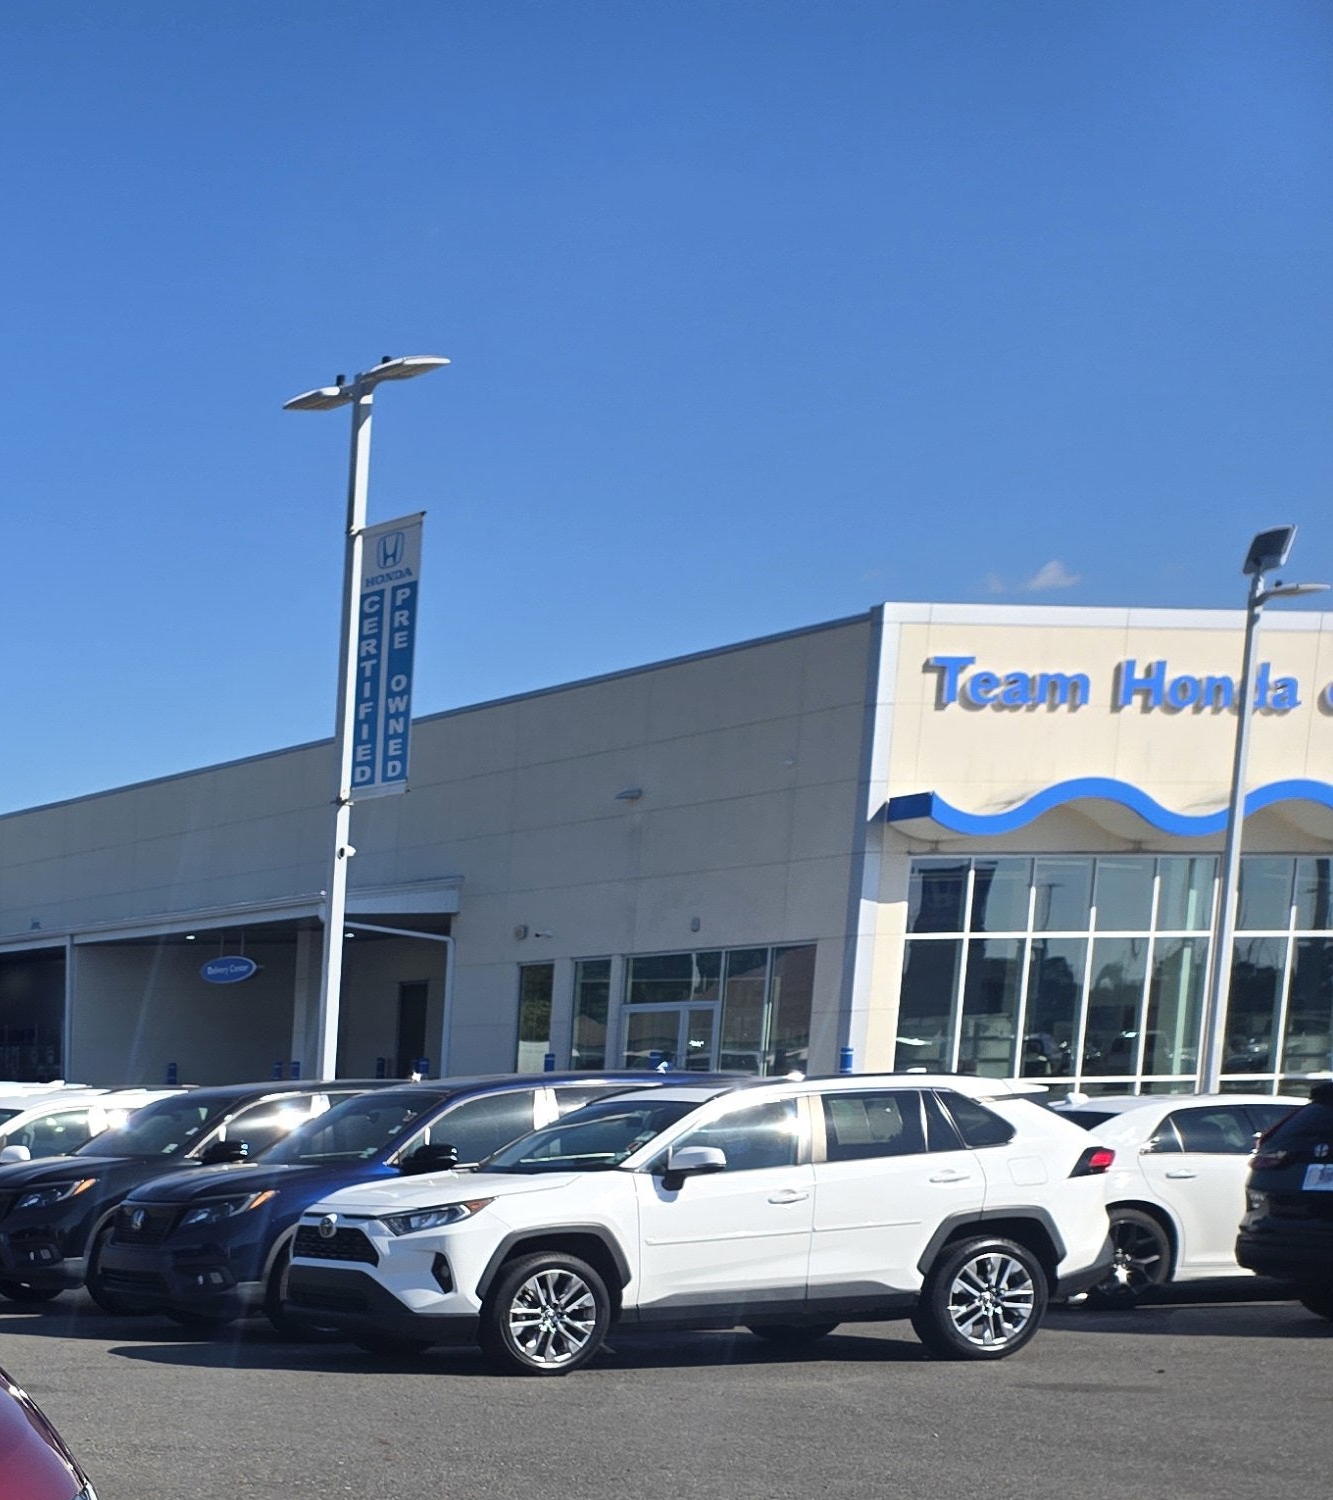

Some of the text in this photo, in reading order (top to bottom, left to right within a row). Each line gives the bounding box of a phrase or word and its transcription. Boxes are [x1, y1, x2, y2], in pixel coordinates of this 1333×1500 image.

[365, 567, 414, 589] HONDA
[354, 594, 381, 784] CERTIFIED
[386, 587, 411, 778] PRE OWNED
[928, 655, 1091, 708] Team
